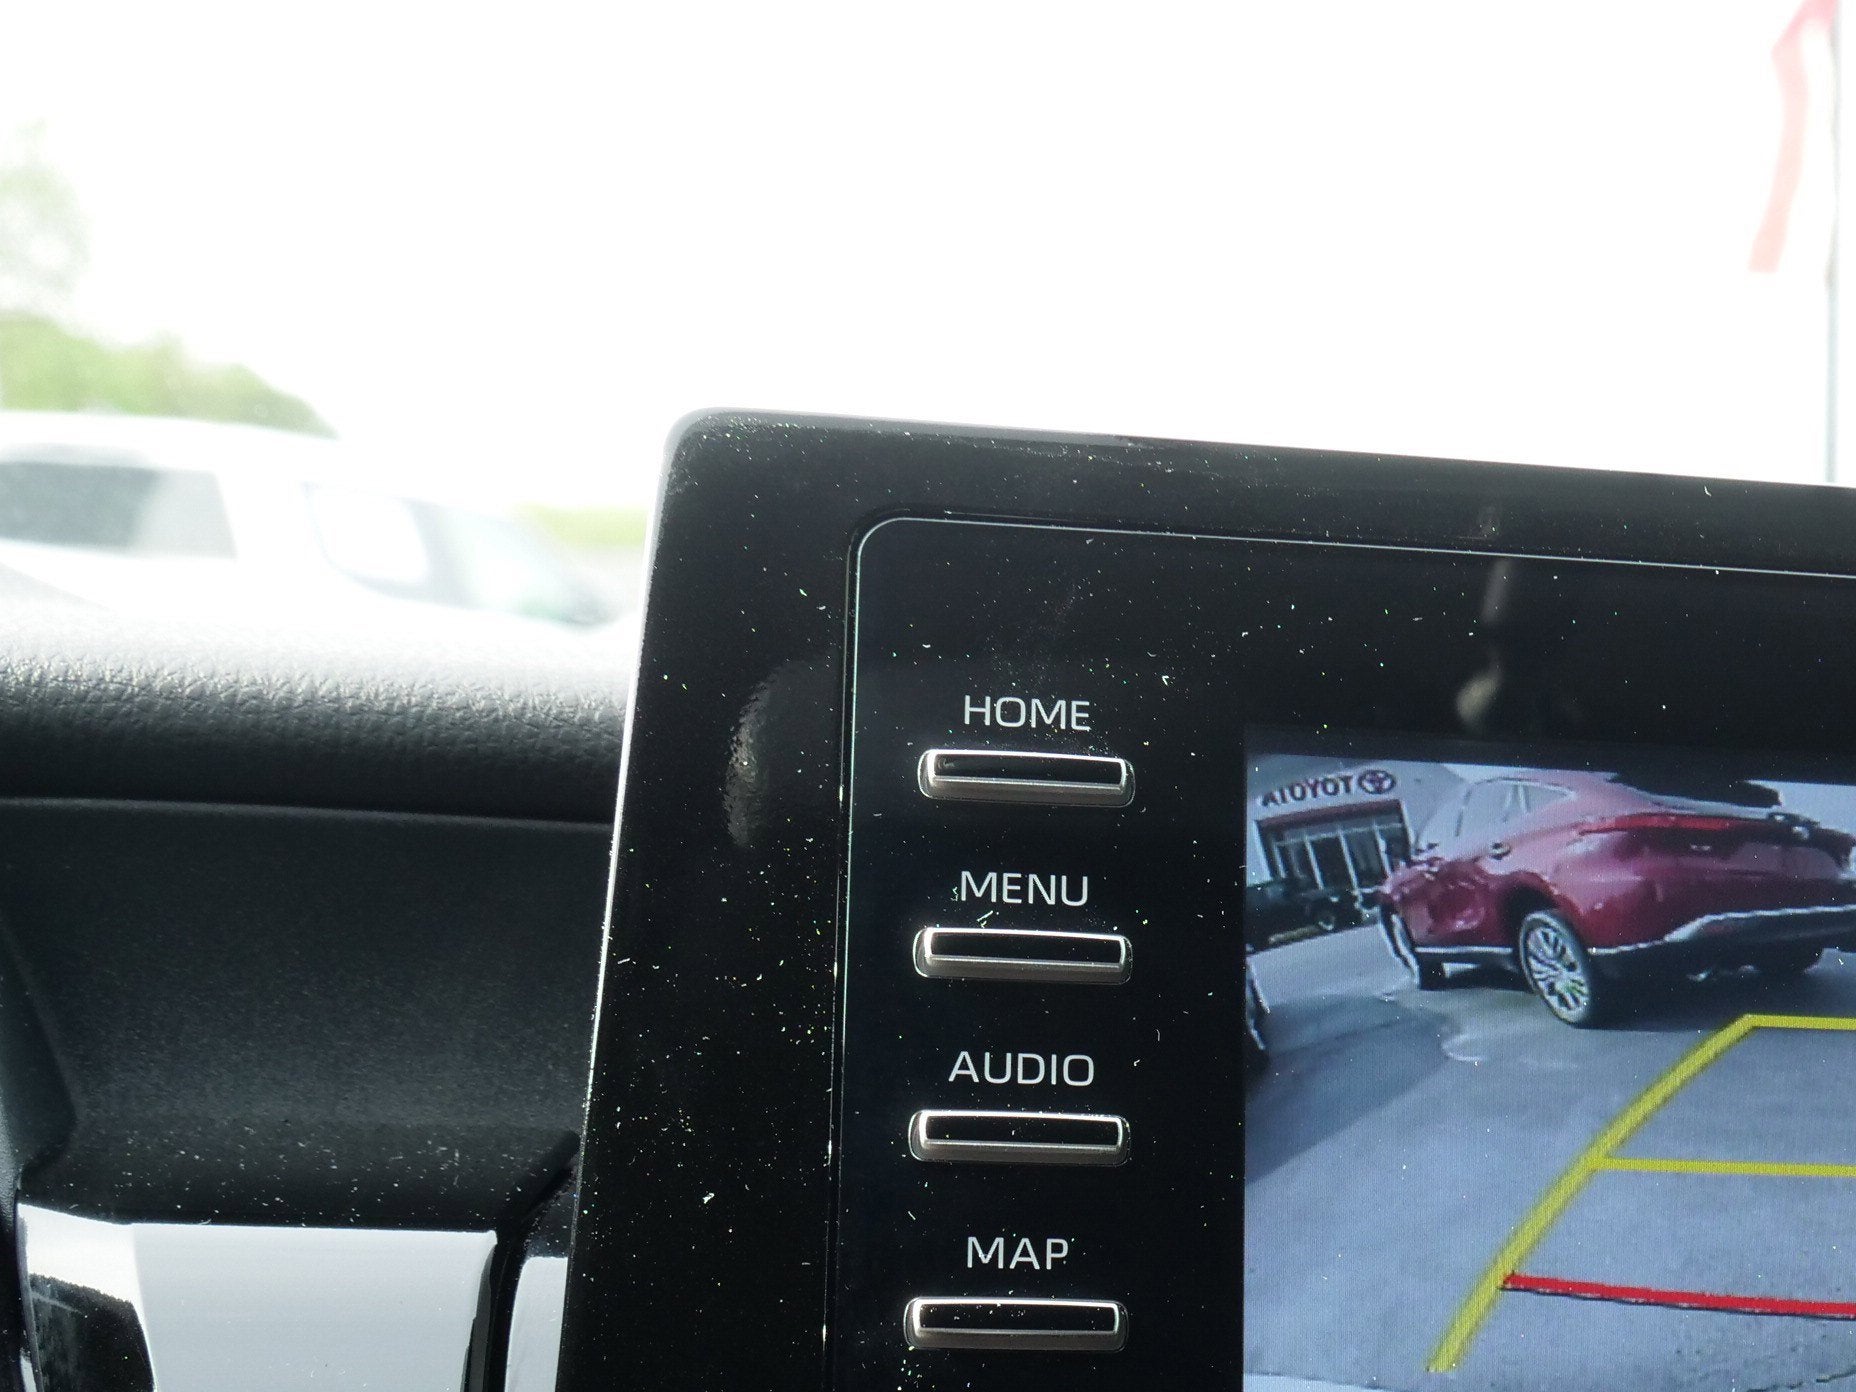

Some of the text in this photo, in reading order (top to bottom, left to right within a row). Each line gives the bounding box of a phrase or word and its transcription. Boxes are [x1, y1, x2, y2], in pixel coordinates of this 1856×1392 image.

[963, 694, 1091, 731] HOME
[959, 870, 1089, 906] MENU
[948, 1051, 1095, 1087] AUDIO
[967, 1235, 1070, 1270] MAP
